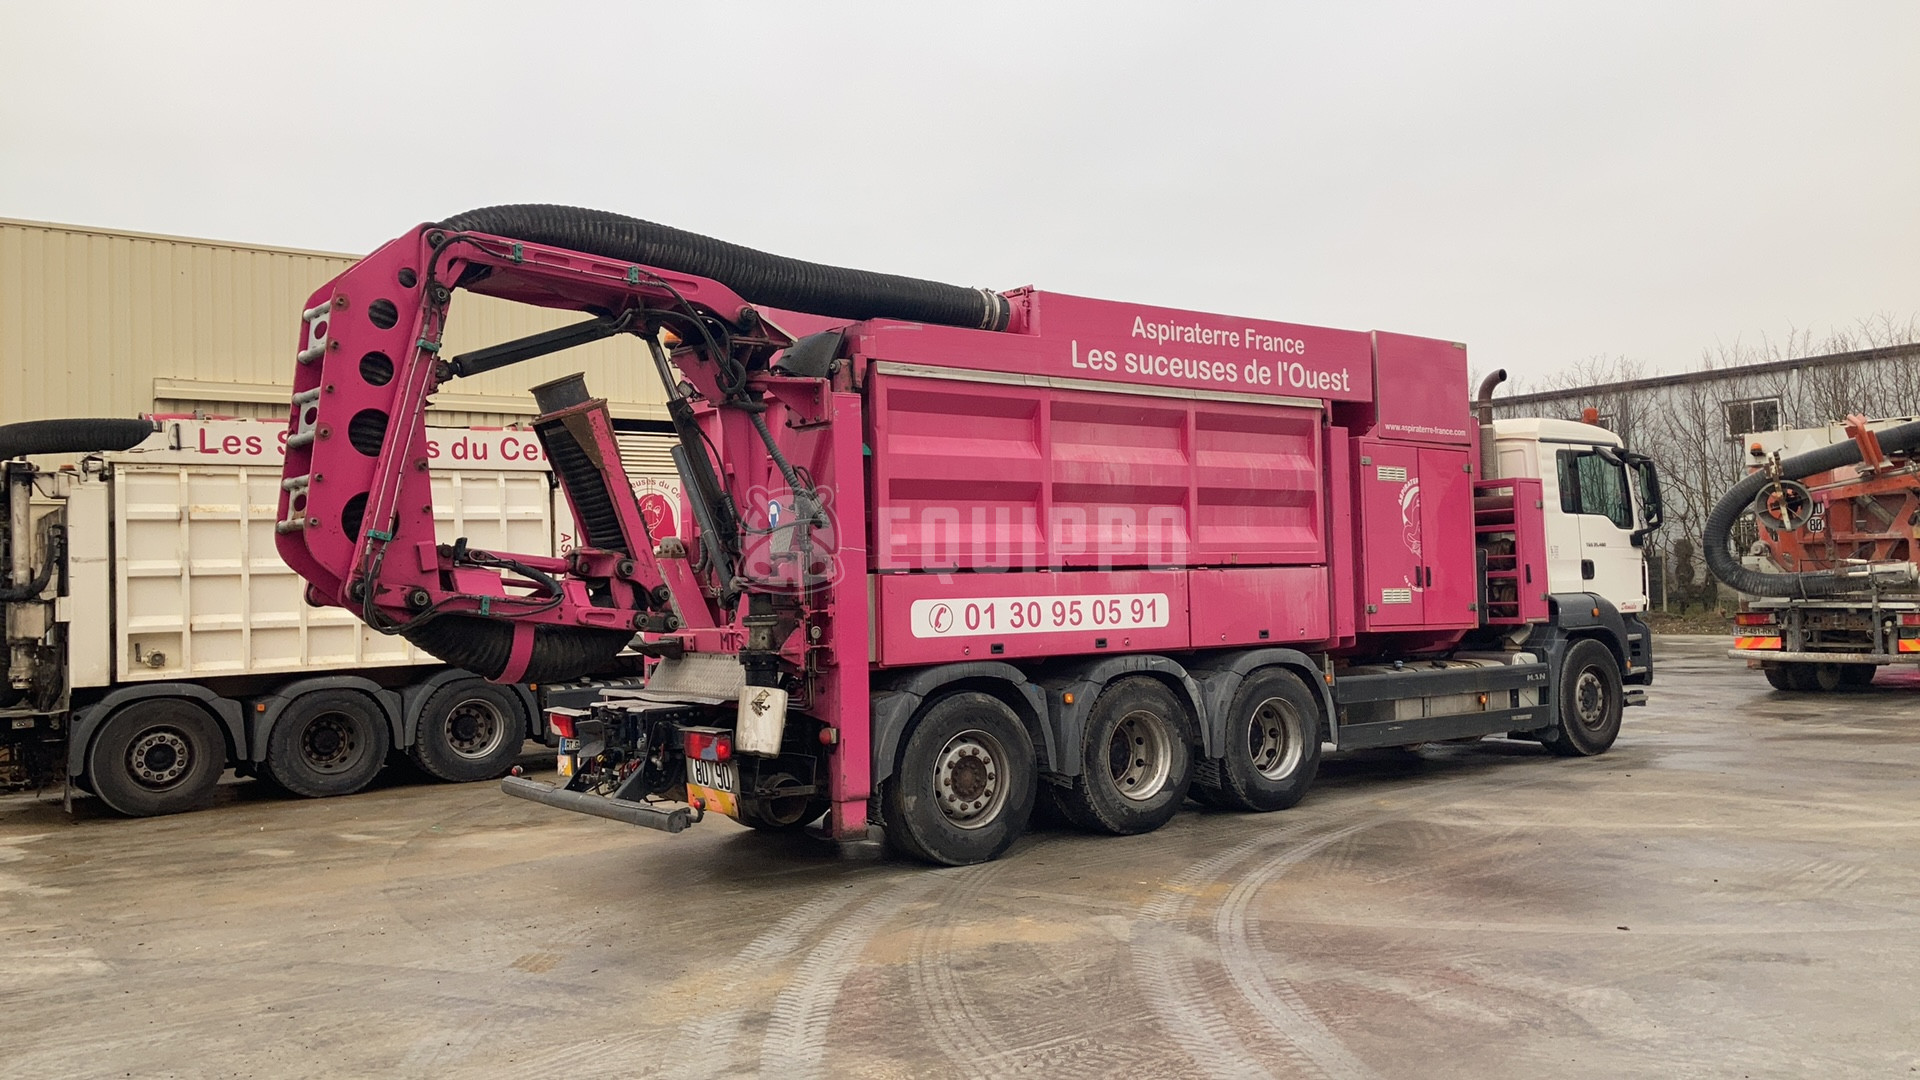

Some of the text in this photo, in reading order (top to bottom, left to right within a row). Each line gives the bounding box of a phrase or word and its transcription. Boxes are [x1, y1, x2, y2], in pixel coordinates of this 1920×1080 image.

[1131, 315, 1305, 355] Aspiraterre France
[1071, 339, 1350, 392] Les suceuses de l'Ouest
[199, 427, 262, 455] Les
[451, 436, 488, 461] du
[1385, 423, 1466, 436] www.aspiraterre-france.com
[658, 480, 670, 490] du
[964, 598, 1157, 631] 01 30 95 05 91
[1526, 673, 1546, 681] MAN
[696, 759, 731, 790] 80 90
